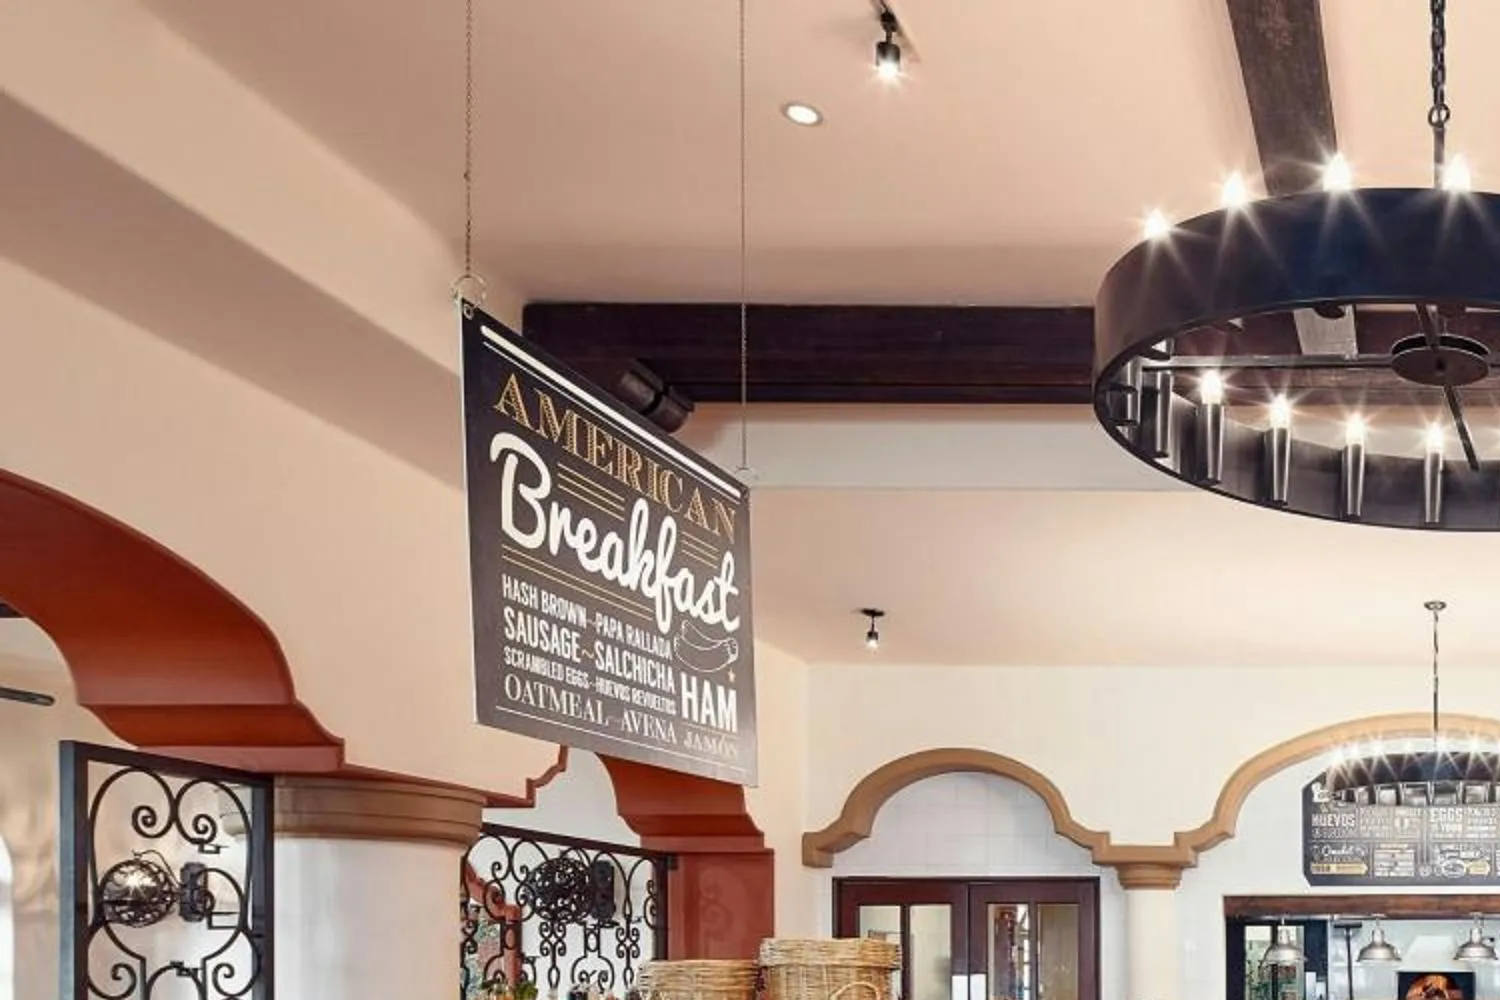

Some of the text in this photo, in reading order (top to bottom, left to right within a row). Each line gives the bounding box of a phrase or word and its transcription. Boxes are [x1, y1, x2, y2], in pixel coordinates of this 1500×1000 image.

[493, 373, 737, 544] AMERICAN
[490, 432, 740, 634] Breakfast
[502, 574, 673, 661] HASH BROWN PAPA RALLADA
[503, 606, 676, 695] SAUSAGE SALCHICHA
[503, 646, 564, 682] SCRAMBLED
[565, 668, 590, 690] EGGS
[595, 676, 631, 703] HUEVOS
[503, 673, 678, 745] OATMEAL AVENA
[680, 671, 738, 733] HAM
